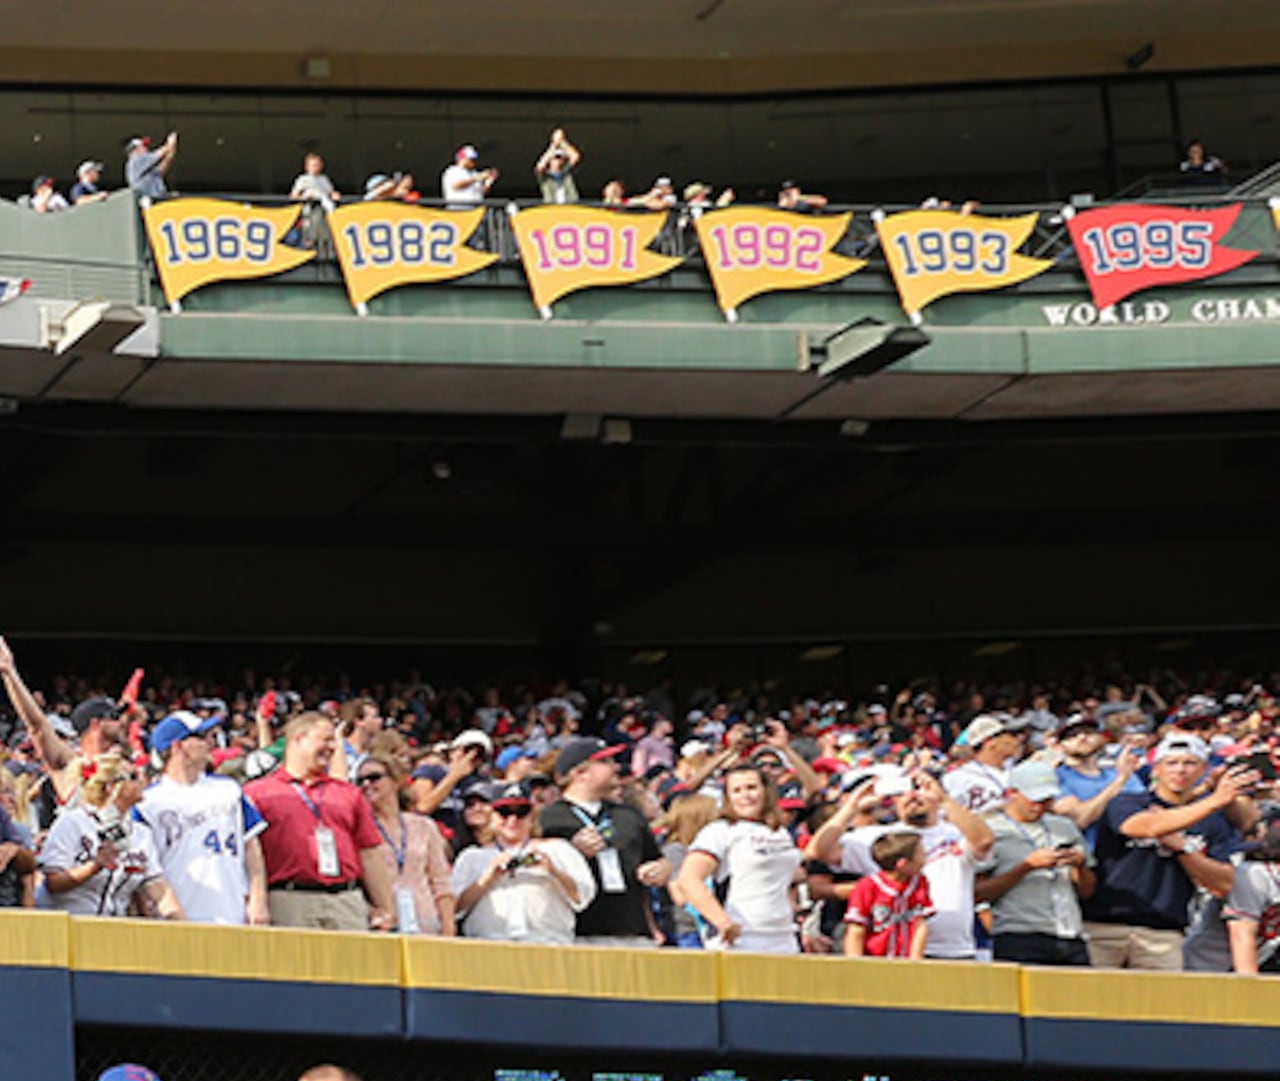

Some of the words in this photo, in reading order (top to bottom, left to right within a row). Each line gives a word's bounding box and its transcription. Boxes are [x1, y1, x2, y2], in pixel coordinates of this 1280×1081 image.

[160, 219, 273, 263] 1969
[344, 222, 456, 266] 1982
[531, 226, 638, 269] 1991
[711, 224, 824, 270] 1992
[895, 231, 1009, 275] 1993
[1083, 222, 1213, 272] 1995
[1042, 302, 1170, 325] WORLD
[203, 830, 239, 857] 44
